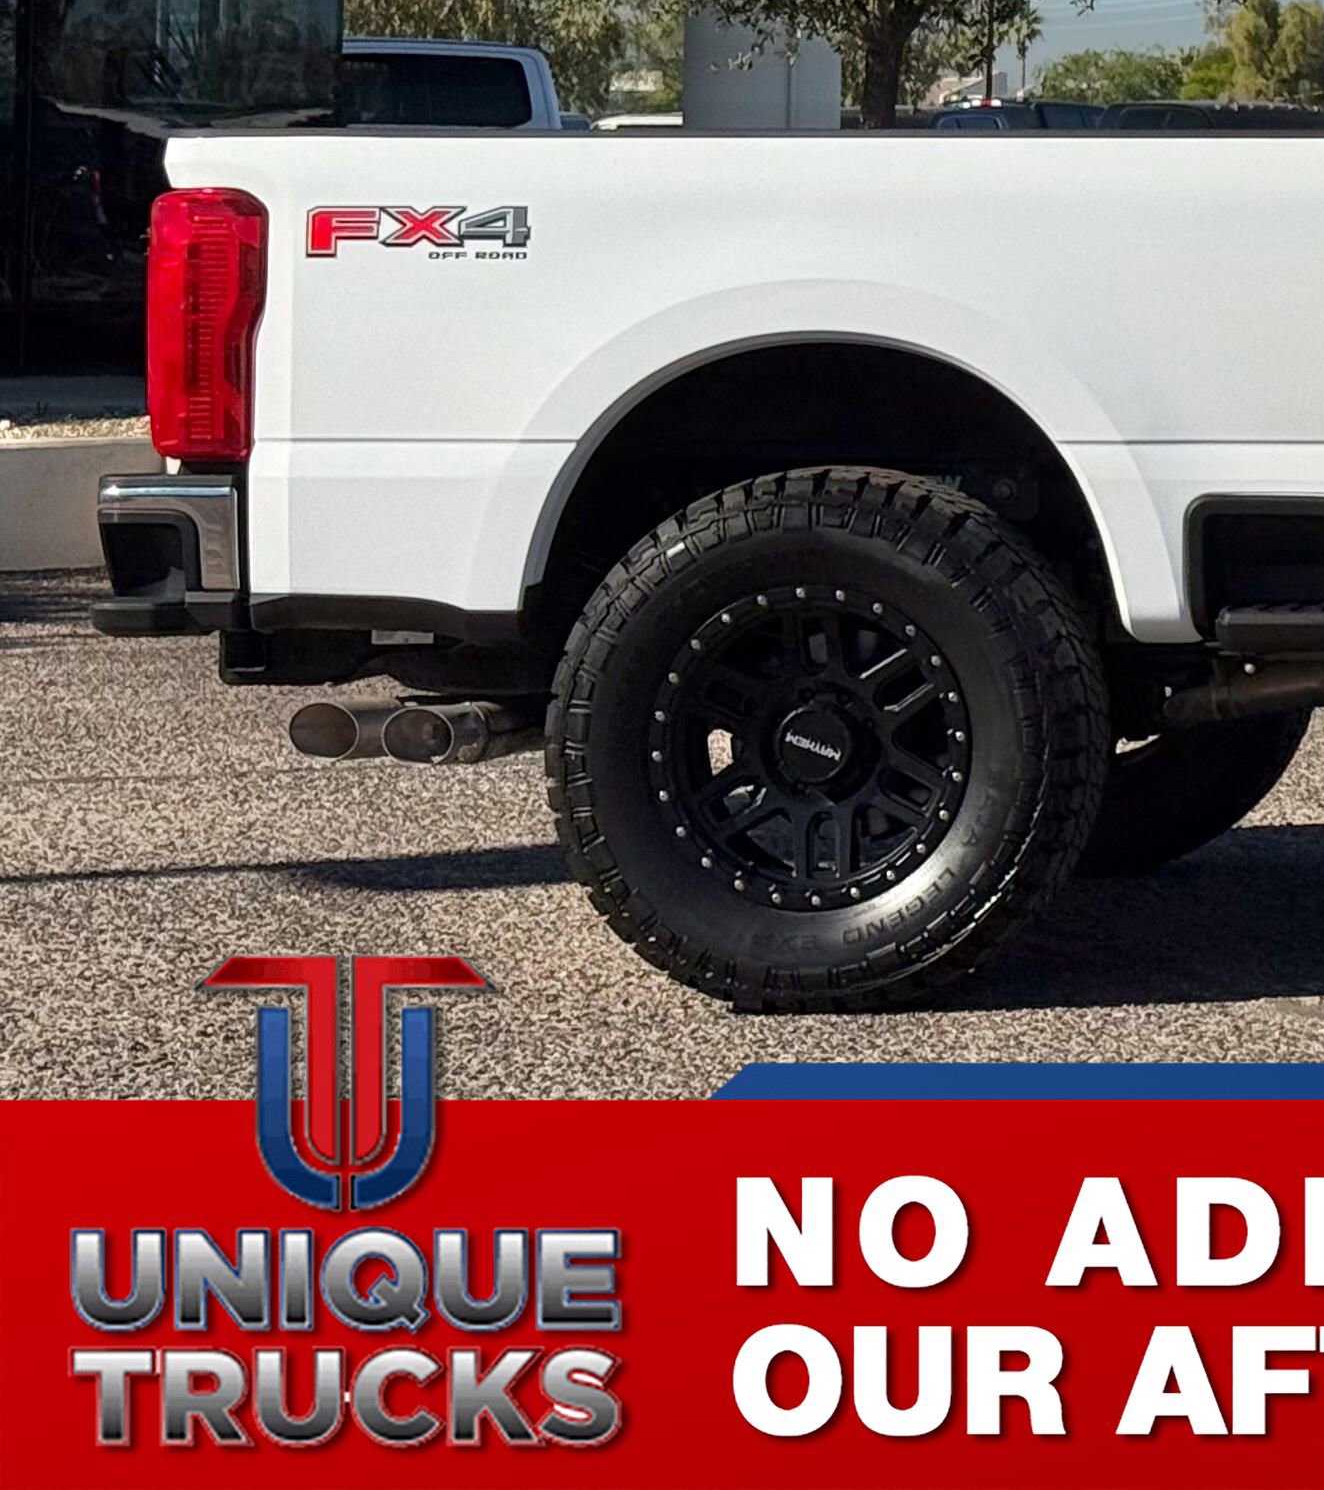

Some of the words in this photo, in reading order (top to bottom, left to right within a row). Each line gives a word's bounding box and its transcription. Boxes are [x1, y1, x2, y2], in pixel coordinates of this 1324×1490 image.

[305, 205, 532, 258] FX4
[428, 251, 468, 259] OFF
[474, 251, 529, 259] ROAD
[842, 866, 956, 944] LEGEND
